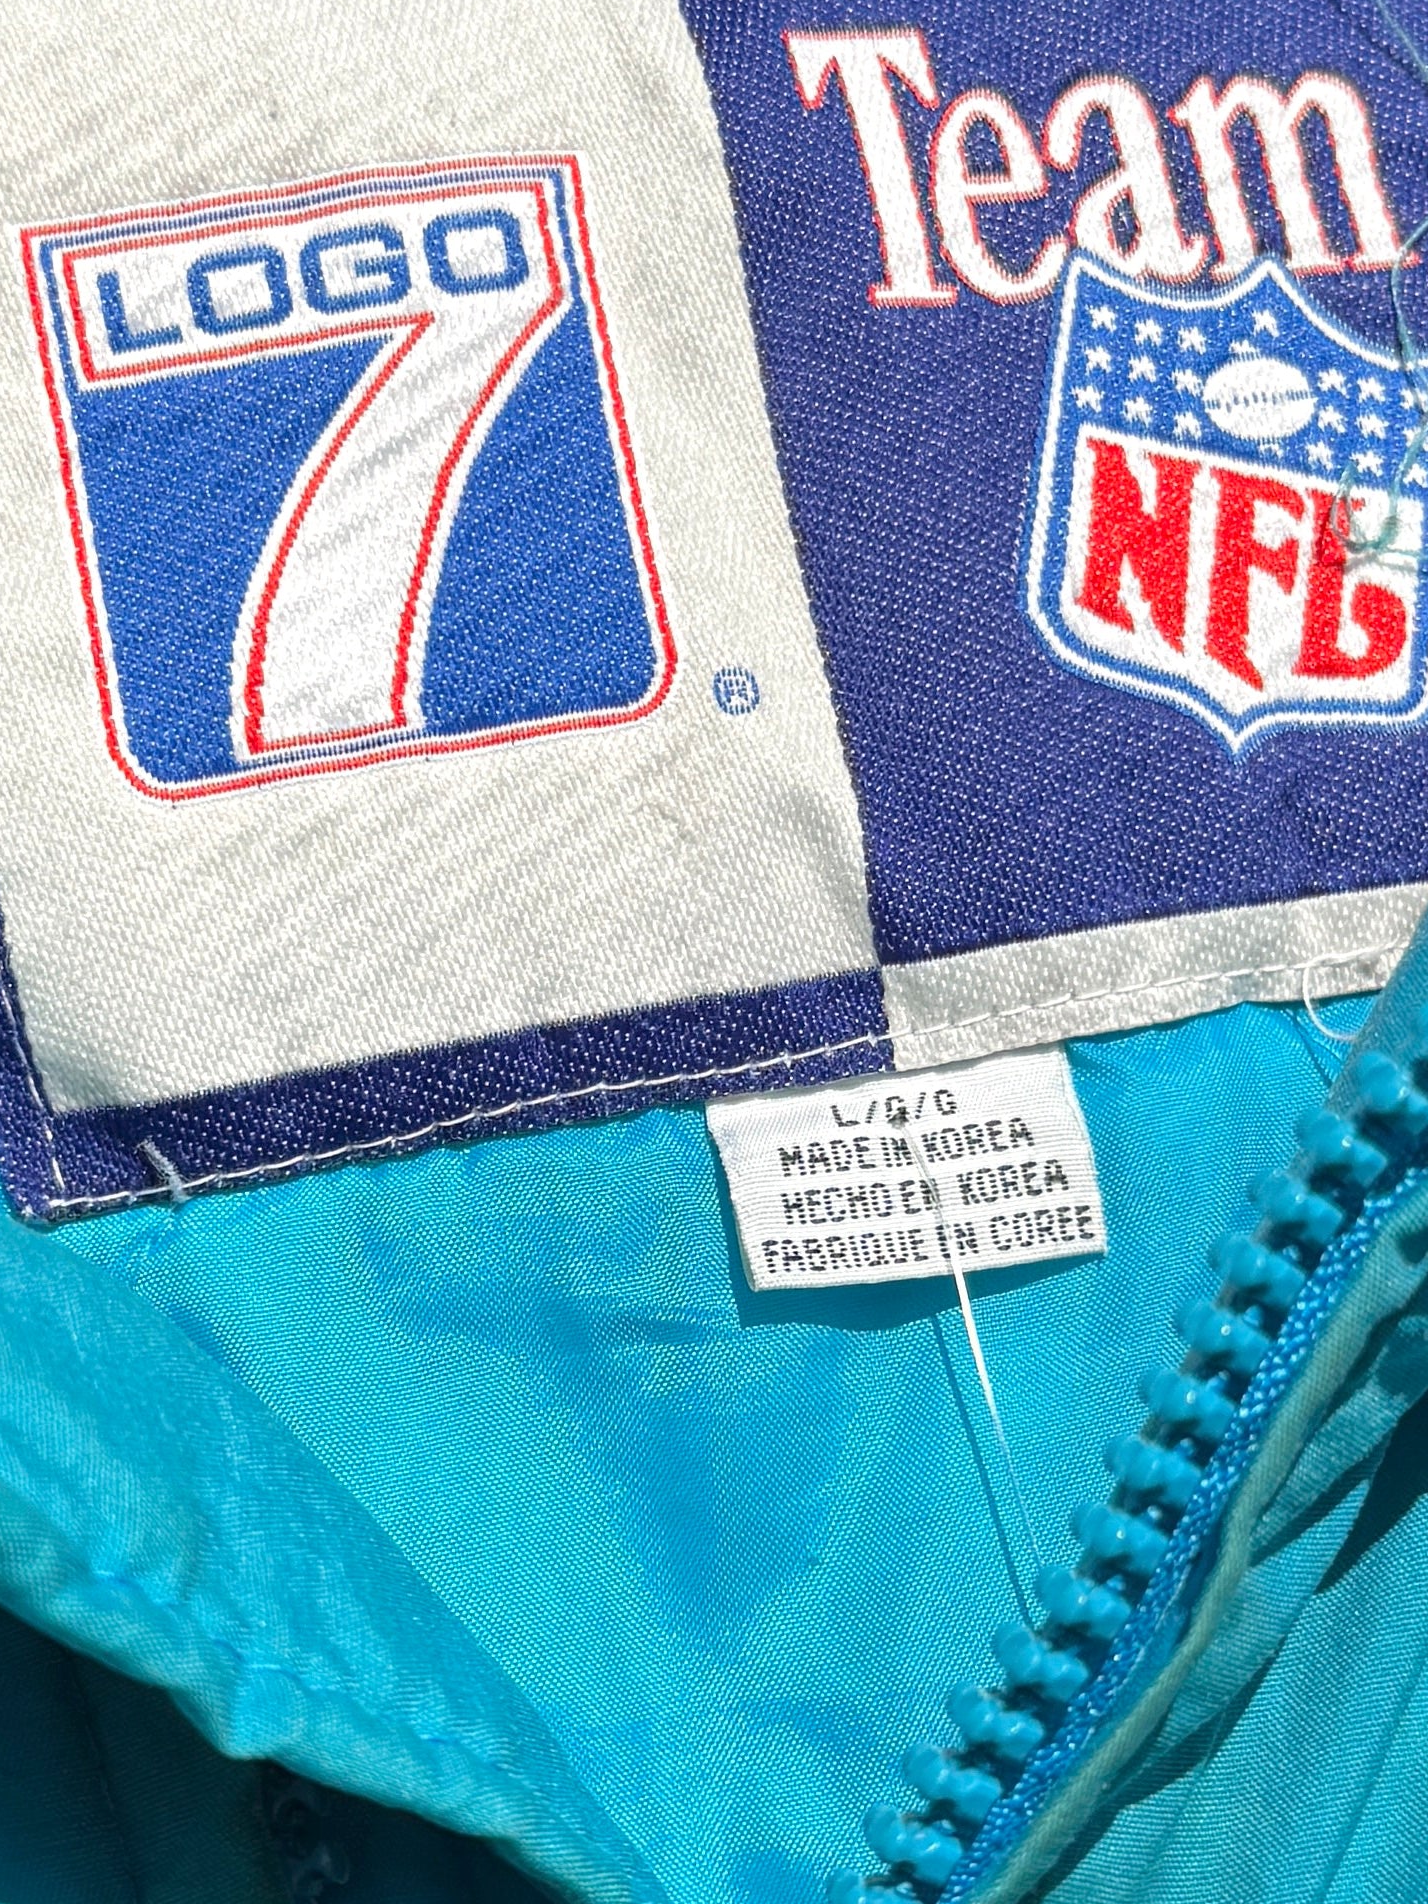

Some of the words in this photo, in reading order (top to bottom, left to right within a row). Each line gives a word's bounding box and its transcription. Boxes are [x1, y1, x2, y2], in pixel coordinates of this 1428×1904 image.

[781, 25, 1422, 310] Team
[97, 207, 530, 356] LOGO
[63, 182, 564, 756] 7
[1070, 434, 1410, 694] NFL
[777, 1136, 877, 1178] MADE
[878, 1136, 914, 1169] IN
[920, 1116, 1036, 1164] KOREA
[830, 1088, 957, 1128] L/G/G
[761, 1228, 928, 1274] FABRIQUE
[988, 1204, 1096, 1252] COREE
[781, 1182, 893, 1226] HECHO
[956, 1159, 1070, 1207] KOREA
